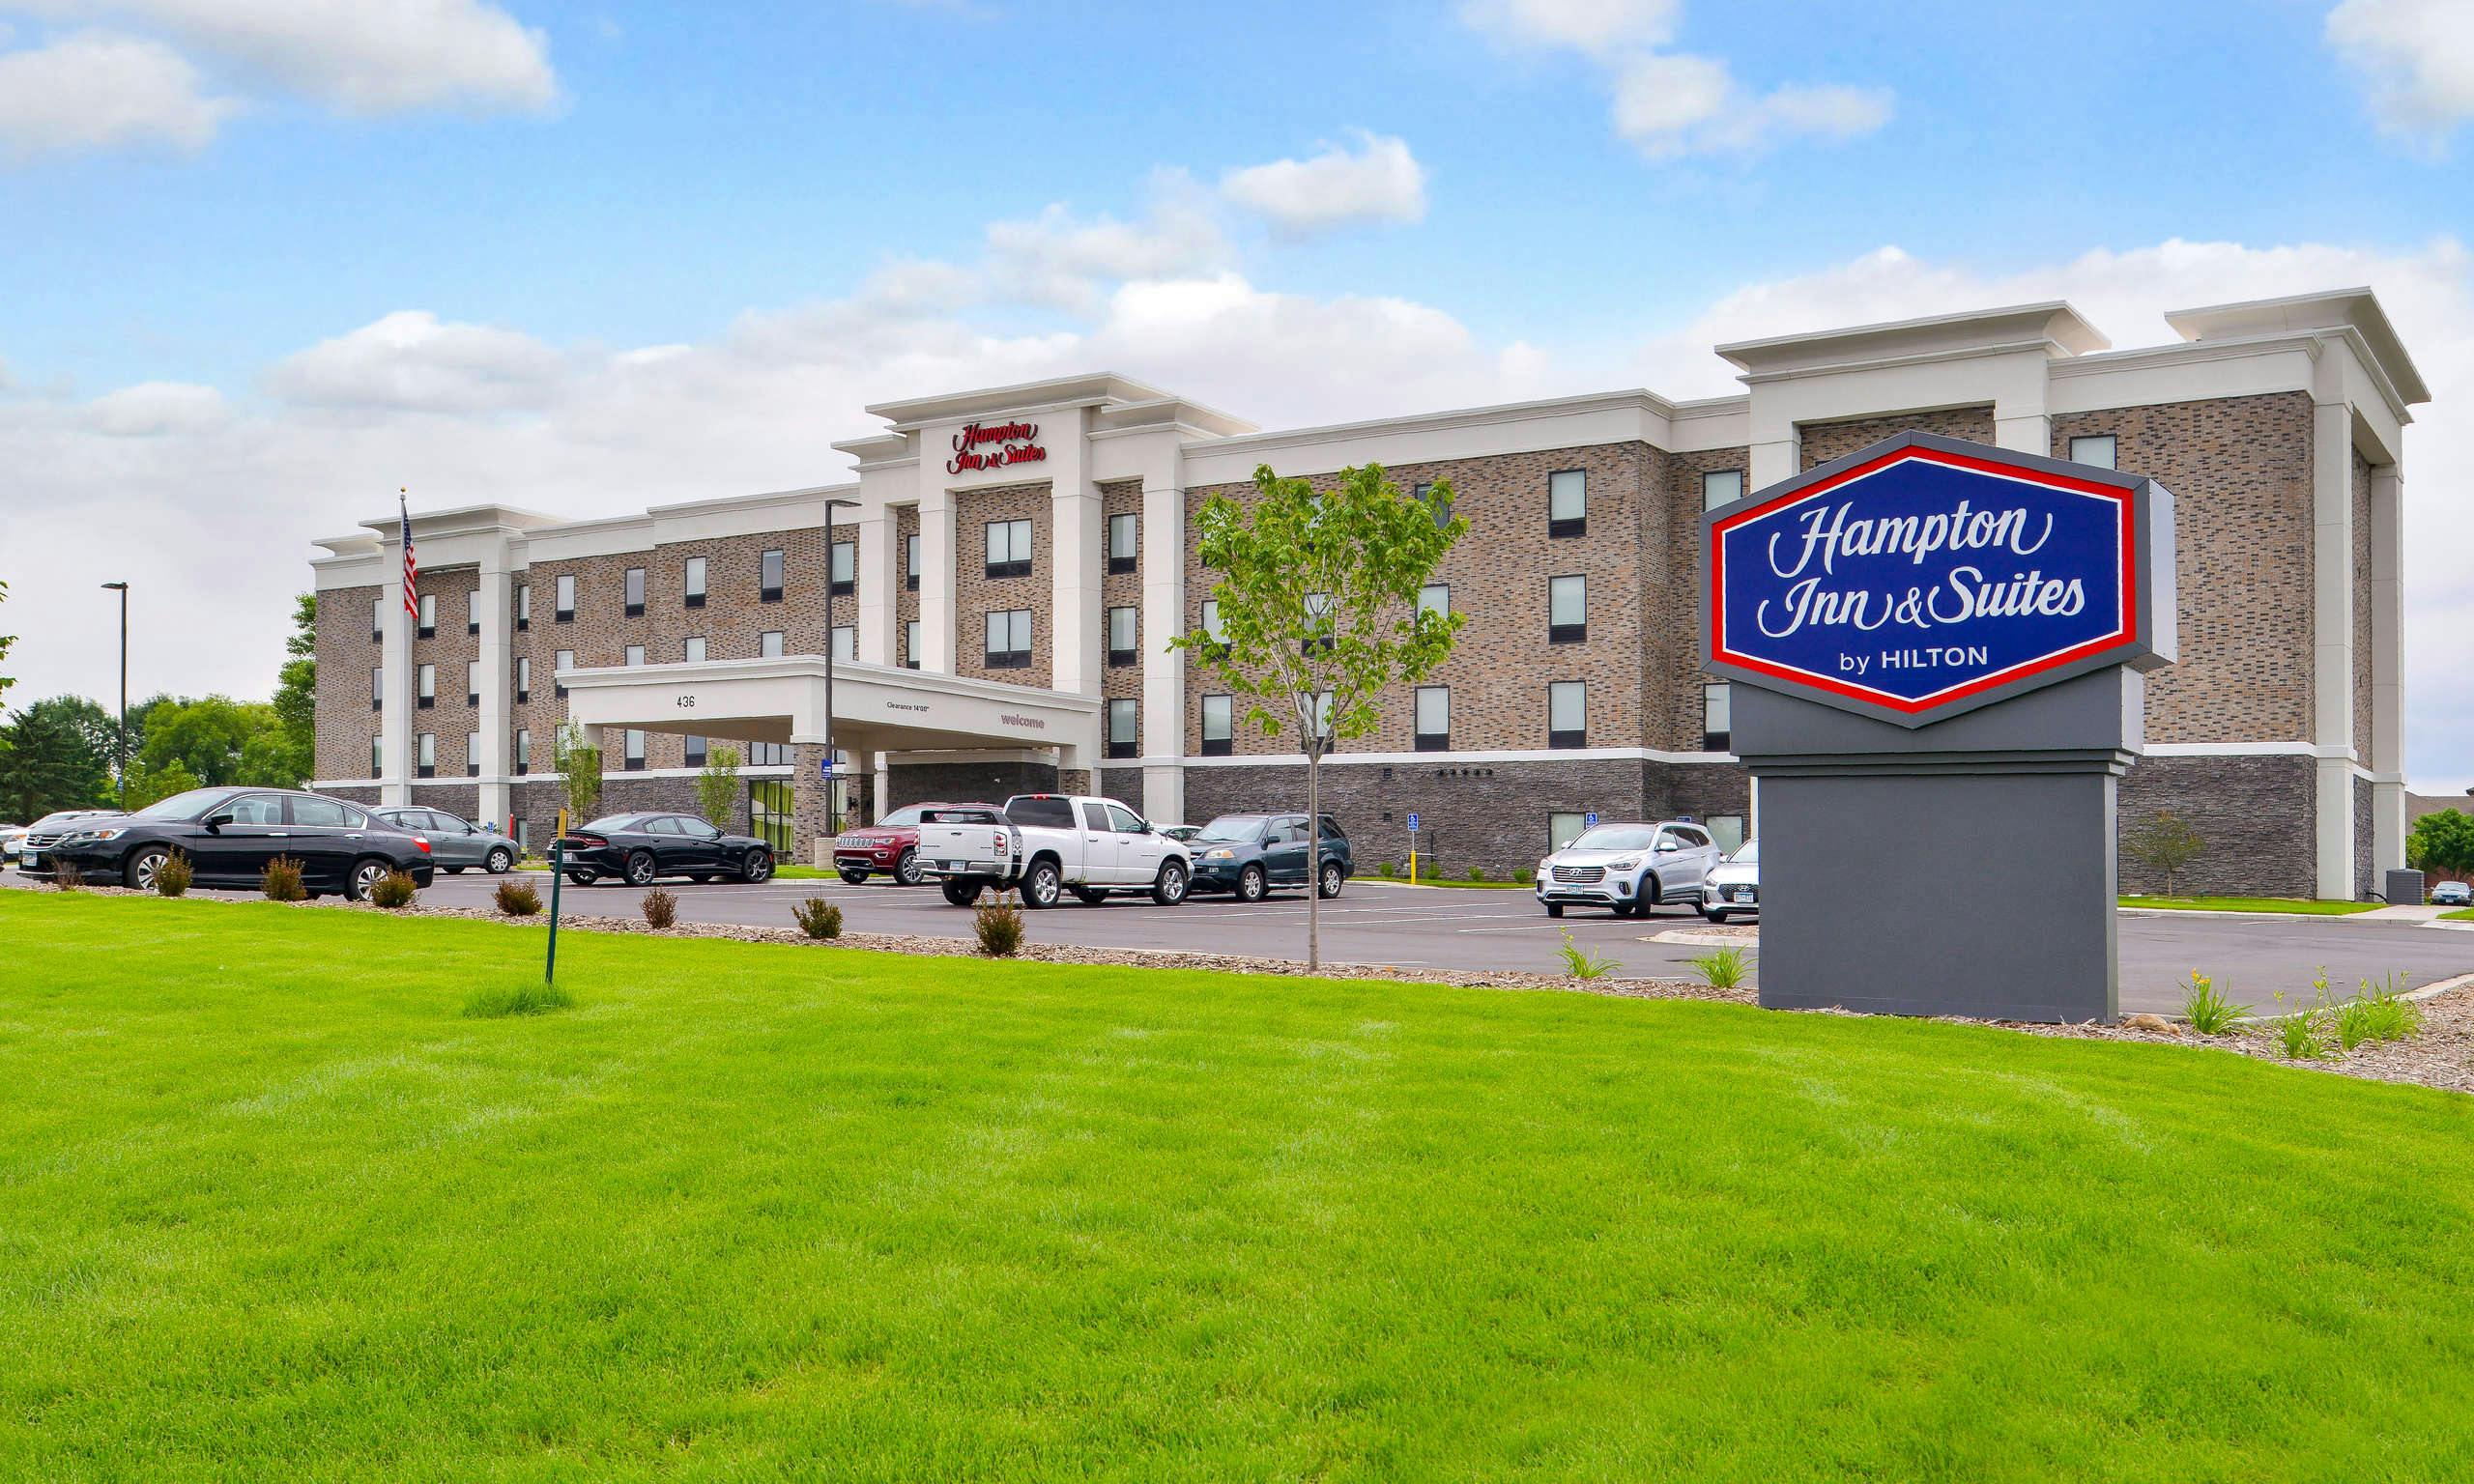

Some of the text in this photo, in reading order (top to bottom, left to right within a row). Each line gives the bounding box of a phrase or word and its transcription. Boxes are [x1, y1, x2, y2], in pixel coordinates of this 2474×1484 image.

[952, 421, 1039, 452] Hampton
[946, 443, 1047, 474] Inn & Suites
[1768, 499, 2054, 579] Hampton
[1757, 565, 2086, 638] Inn & Suites
[1840, 645, 1988, 675] by HILTON
[676, 696, 695, 708] 436
[886, 701, 911, 711] Clearance
[1000, 713, 1045, 729] welcome
